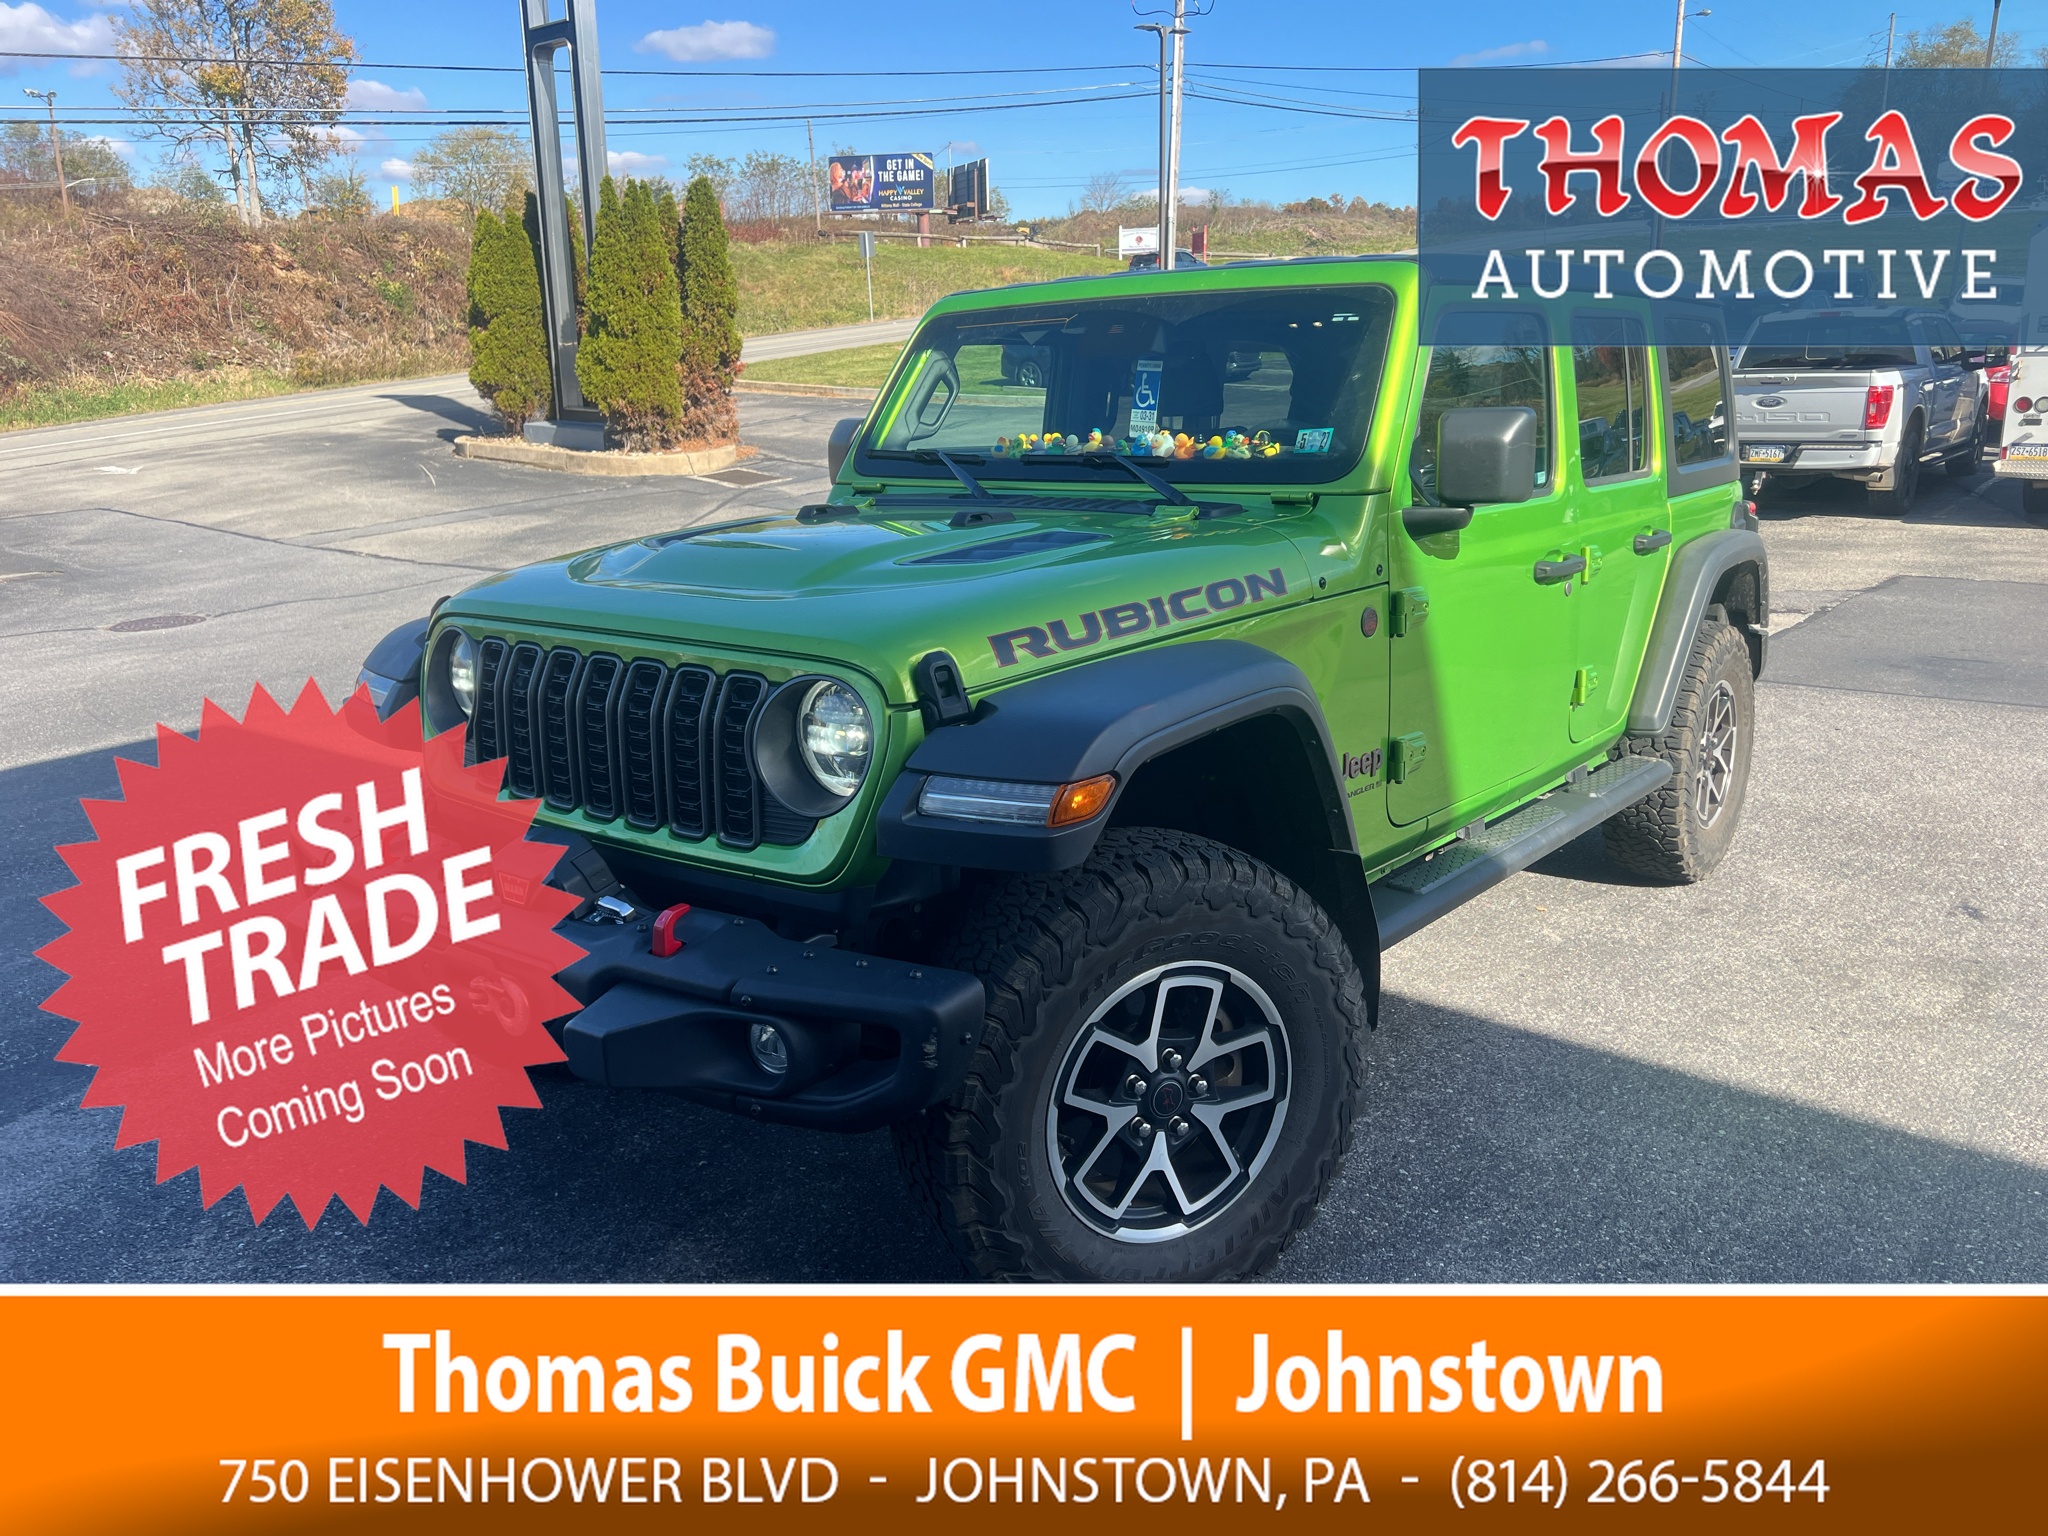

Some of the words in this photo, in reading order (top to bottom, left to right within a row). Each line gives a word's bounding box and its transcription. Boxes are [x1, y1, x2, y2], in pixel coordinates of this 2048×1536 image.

[887, 159, 903, 171] GET
[905, 158, 914, 170] IN
[878, 171, 895, 182] THE
[896, 170, 924, 182] GAME!
[1140, 410, 1155, 421] 03-31
[1736, 411, 1830, 423] -150
[987, 567, 1289, 668] RUBICON
[1342, 747, 1384, 779] Jeep
